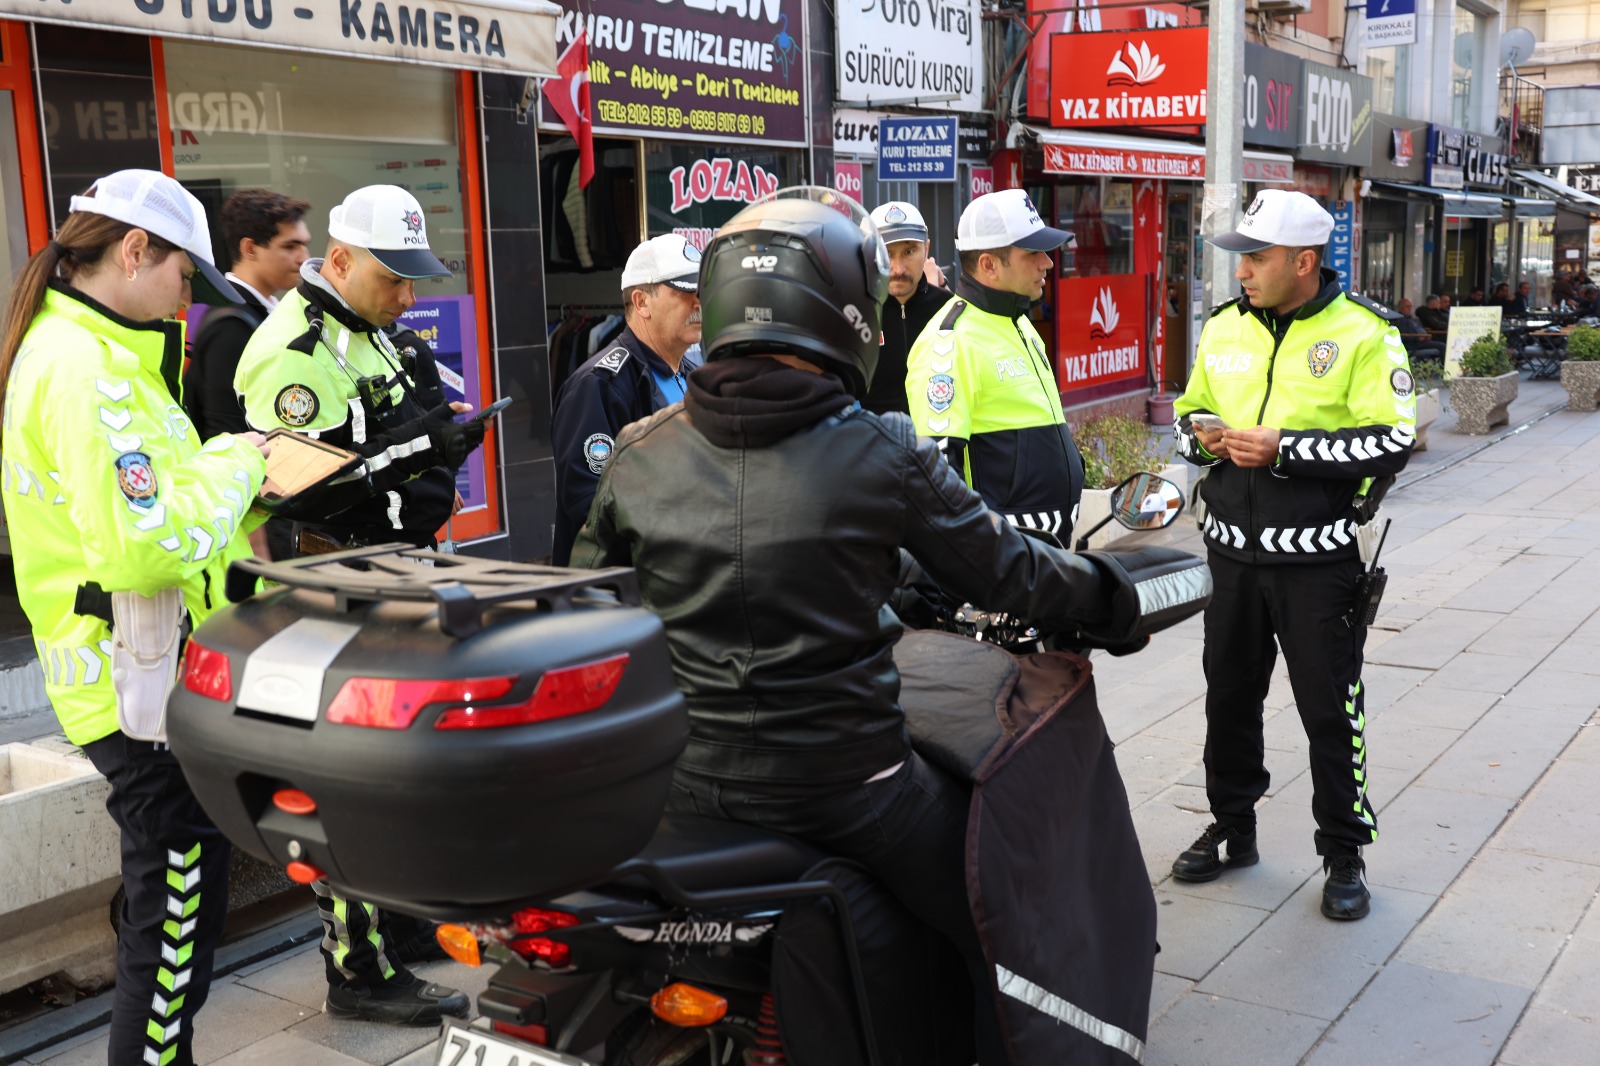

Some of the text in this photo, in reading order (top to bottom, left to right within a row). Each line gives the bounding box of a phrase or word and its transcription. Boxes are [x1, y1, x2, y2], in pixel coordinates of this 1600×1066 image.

[340, 1, 507, 58] KAMERA
[555, 10, 634, 52] KURU
[881, 0, 972, 46] Oto Viraj
[1367, 20, 1413, 32] KIRIKKALE
[630, 64, 679, 100] Abiye
[695, 72, 729, 99] Deri
[845, 43, 973, 95] SÜRÜCÜ KURSU
[598, 99, 626, 122] TEL:
[627, 102, 650, 126] 212
[650, 105, 668, 127] 55
[667, 107, 683, 128] 39
[690, 109, 716, 131] 0505
[717, 111, 737, 133] 517
[737, 113, 751, 134] 69
[1060, 88, 1207, 120] YAZ KİTABEVİ
[1243, 74, 1258, 128] O
[1306, 73, 1353, 153] FOTO
[882, 145, 905, 158] KURU
[906, 142, 952, 158] TEMİZLEME
[886, 125, 949, 142] LOZAN
[175, 154, 201, 165] GROUP
[889, 161, 944, 172] TEL: 212 55 39
[1069, 152, 1084, 169] YAZ
[1086, 150, 1124, 171] KİTABEVİ
[1142, 158, 1155, 174] YAZ
[669, 158, 778, 214] LOZAN
[835, 173, 861, 192] Oto
[972, 177, 992, 194] Oto
[741, 255, 778, 268] EVO
[842, 304, 872, 344] EVO
[1065, 339, 1139, 383] YAZ KİTABEVİ
[653, 922, 735, 943] HONDA
